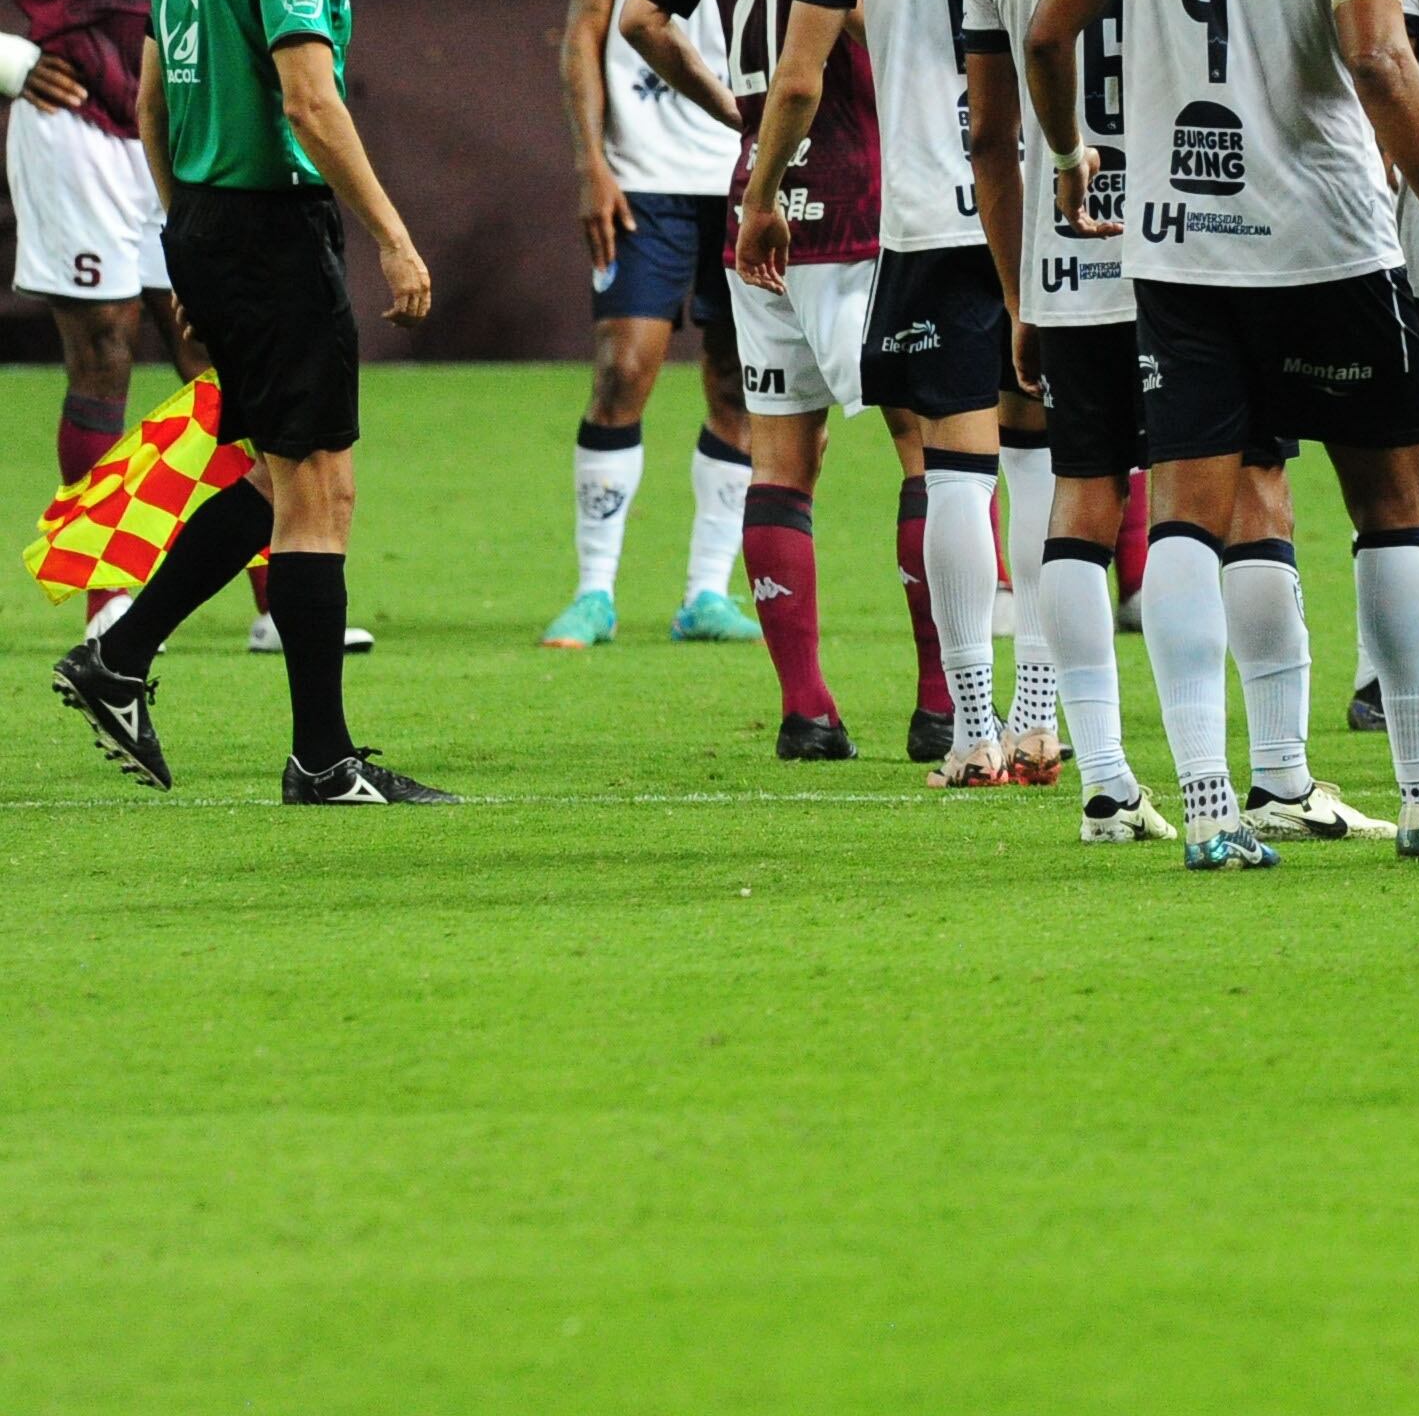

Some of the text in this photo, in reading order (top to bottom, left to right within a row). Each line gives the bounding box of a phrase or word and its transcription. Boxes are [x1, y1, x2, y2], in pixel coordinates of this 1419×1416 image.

[1173, 129, 1244, 151] BURGER
[1170, 149, 1246, 180] KING
[1142, 201, 1187, 244] UH
[1186, 222, 1272, 236] HISPANOAMERICANA
[1187, 212, 1243, 225] UNIVERSIDAD
[74, 253, 101, 287] S
[1042, 256, 1079, 293] UH
[745, 365, 785, 395] CA
[1282, 356, 1373, 381] Montaña
